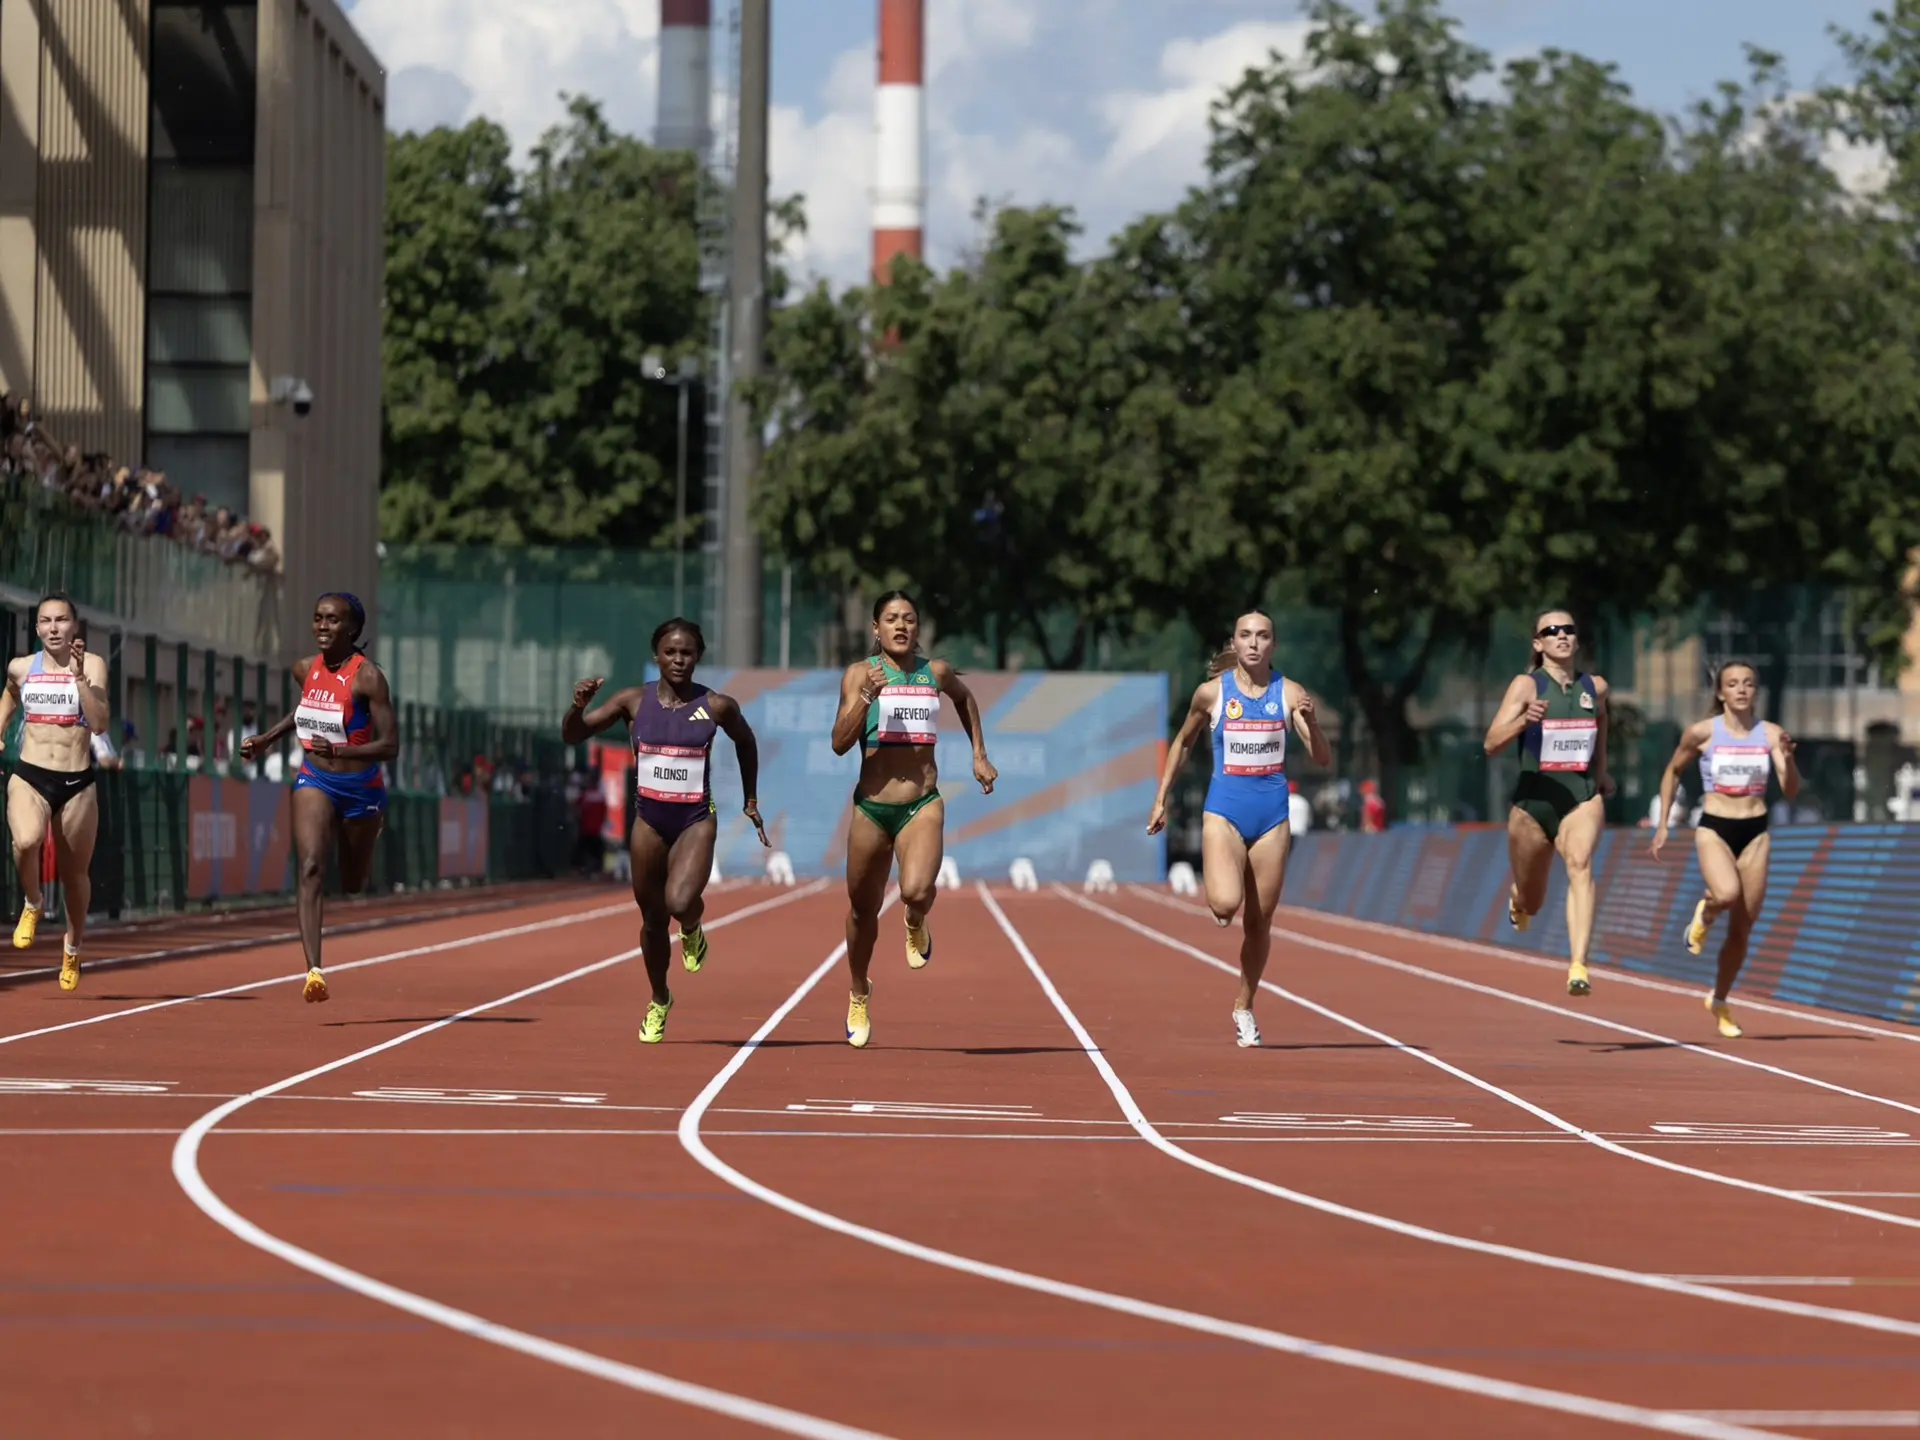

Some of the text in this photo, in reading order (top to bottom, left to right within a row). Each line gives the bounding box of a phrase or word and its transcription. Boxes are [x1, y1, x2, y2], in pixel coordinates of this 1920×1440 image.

[25, 693, 66, 705] MAKSIMOVA
[308, 689, 335, 702] CUBA
[893, 707, 930, 720] AZEVEDO
[1230, 742, 1280, 755] KOMBAROVA
[1553, 740, 1589, 752] FILATOVA
[653, 766, 688, 781] ALONSO
